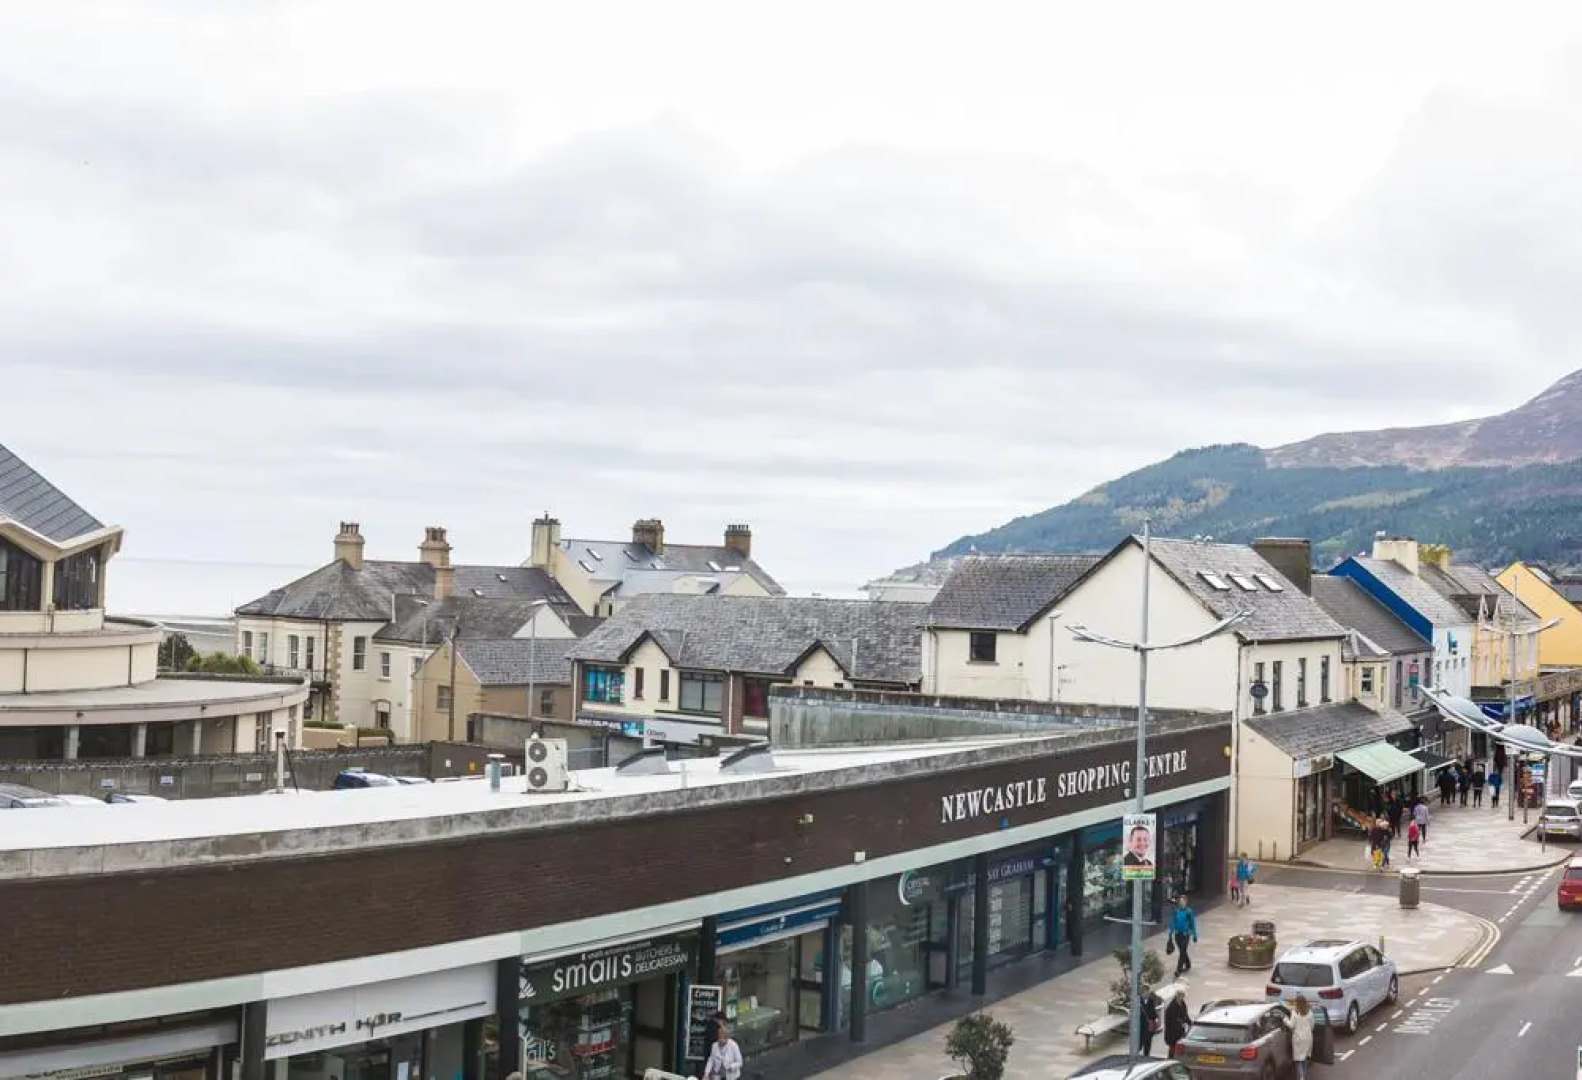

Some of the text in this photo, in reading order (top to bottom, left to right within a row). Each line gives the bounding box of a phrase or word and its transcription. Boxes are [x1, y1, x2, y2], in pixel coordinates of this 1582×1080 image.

[941, 777, 1046, 823] NEWCASTLE
[1058, 761, 1130, 798] SHOPPING
[265, 1021, 347, 1047] ZENITH
